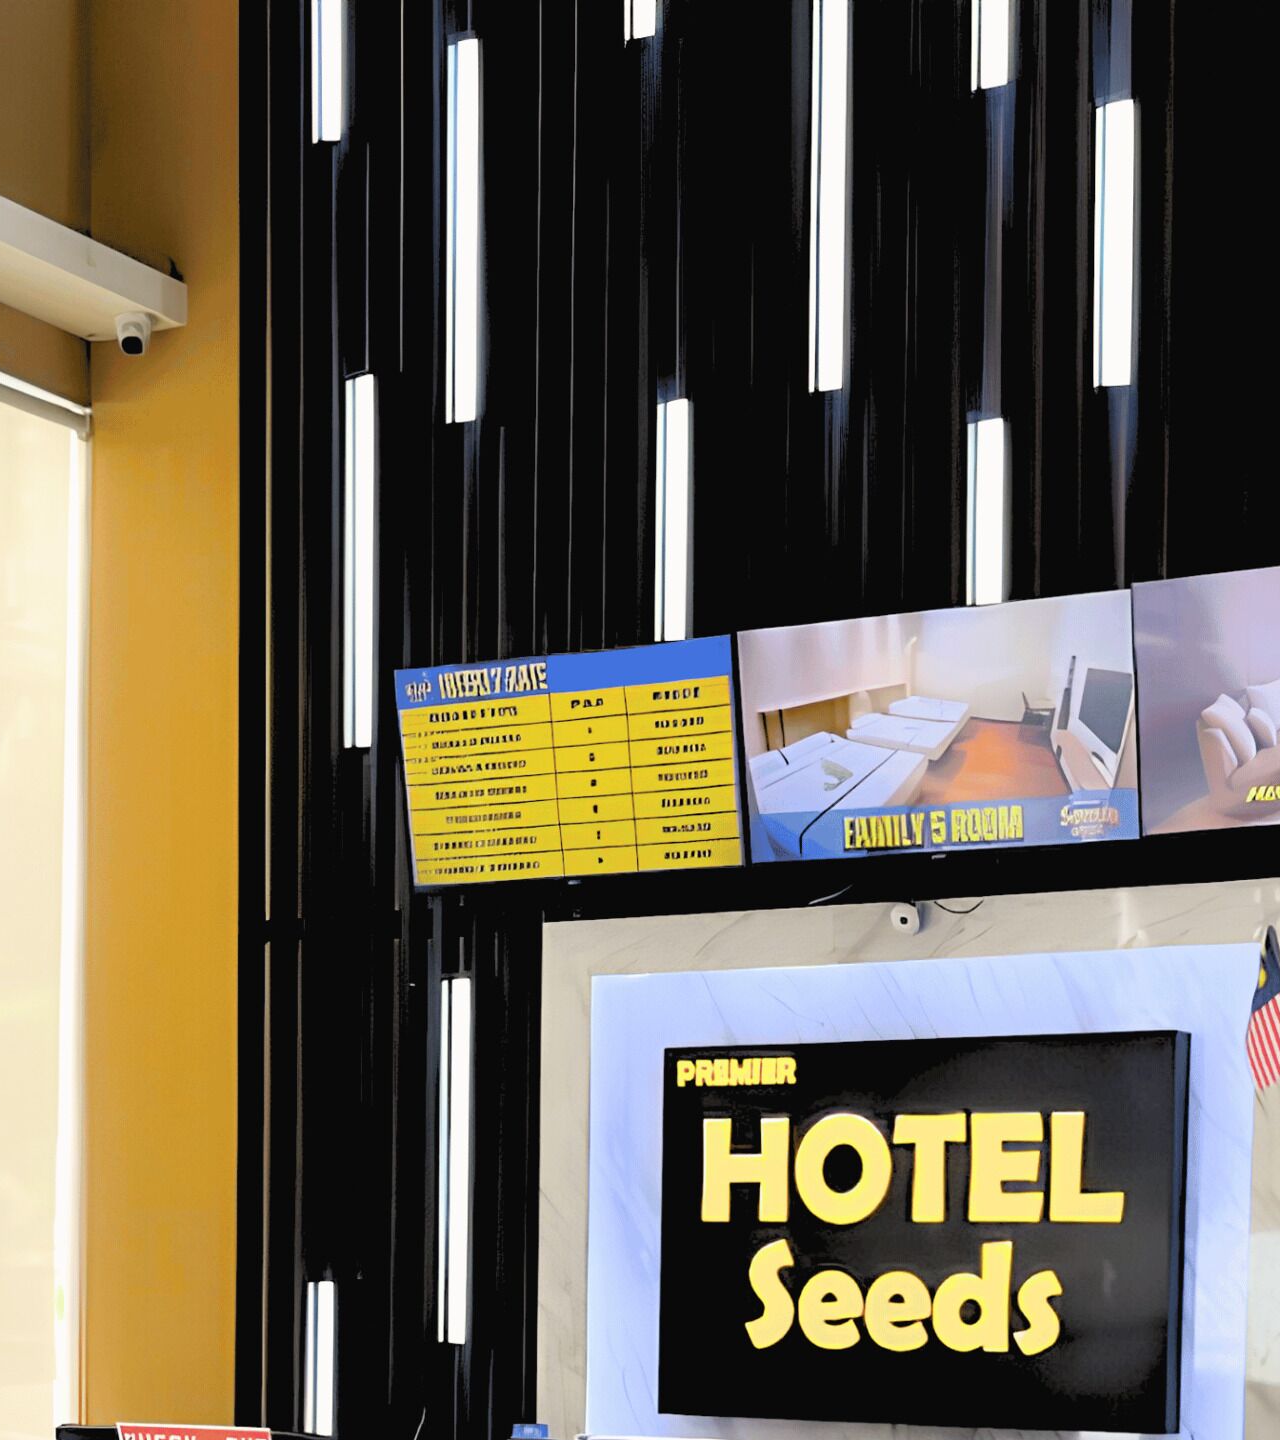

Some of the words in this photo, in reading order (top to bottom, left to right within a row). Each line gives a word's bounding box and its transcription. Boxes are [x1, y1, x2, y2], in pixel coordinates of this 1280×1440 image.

[843, 813, 925, 849] FAMILY
[951, 805, 1025, 843] ROOM
[677, 1057, 797, 1088] PREMIER
[701, 1110, 1125, 1226] HOTEL
[744, 1237, 1064, 1357] Seeds
